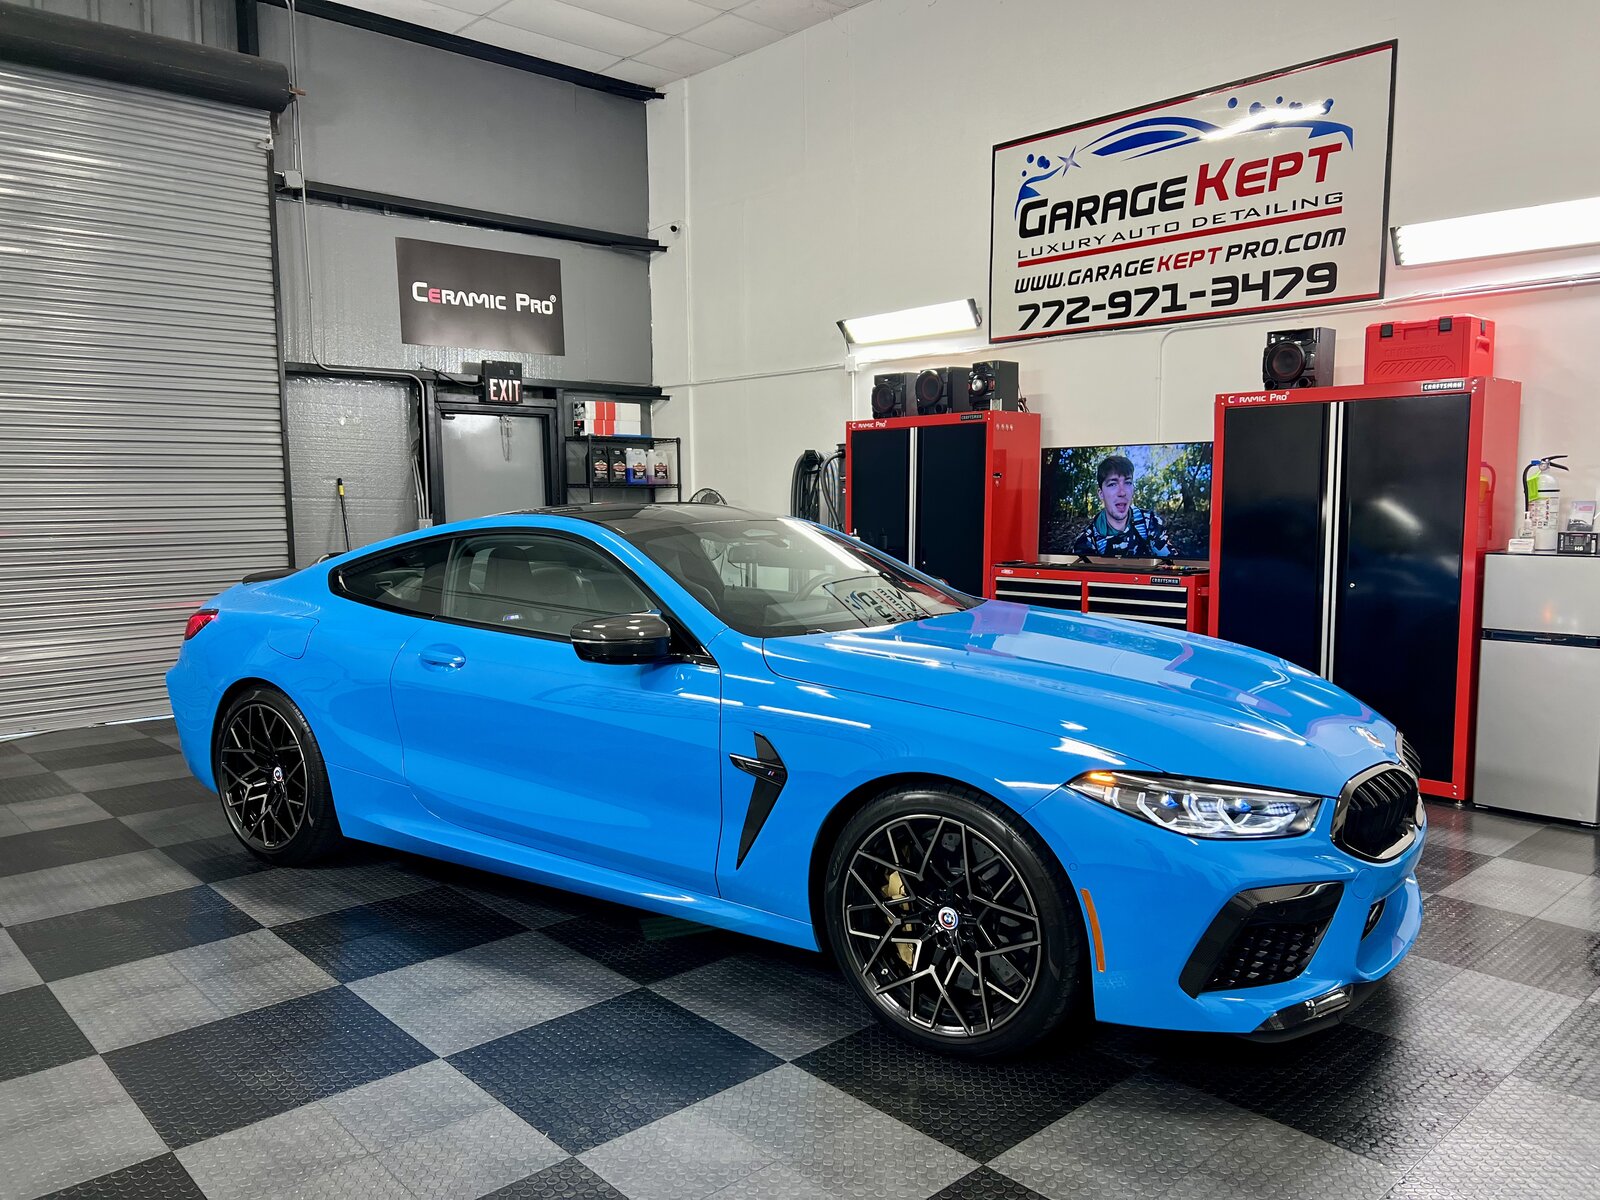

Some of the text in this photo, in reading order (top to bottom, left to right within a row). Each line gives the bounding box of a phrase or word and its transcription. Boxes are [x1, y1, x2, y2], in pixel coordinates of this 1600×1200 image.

[1019, 142, 1343, 239] GARAGE KEPT
[1017, 191, 1344, 260] LUXURY AUTO DETAILING
[412, 281, 507, 311] CERAMIC
[1018, 261, 1338, 332] 772-971-3479
[489, 378, 521, 402] EXIT
[1228, 395, 1267, 404] CRAMIC
[1423, 381, 1462, 390] CRAFTSMAN
